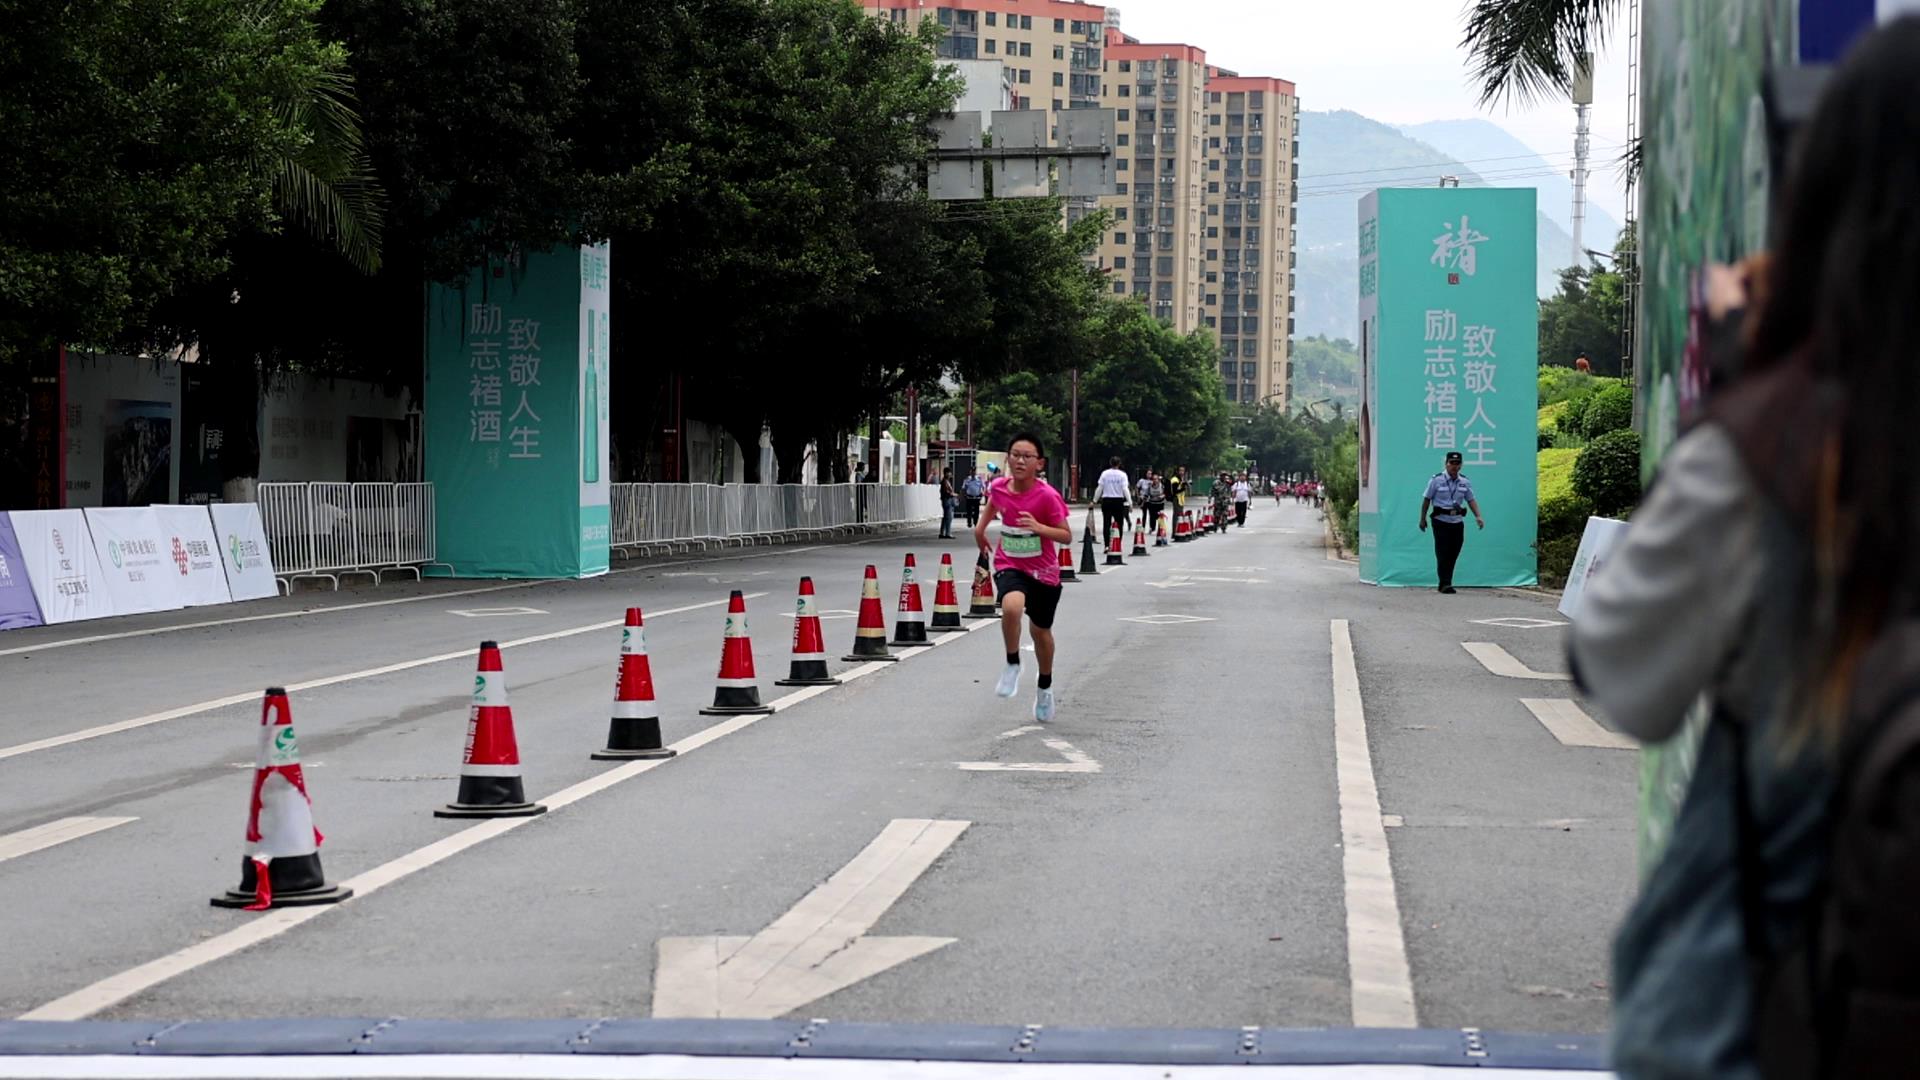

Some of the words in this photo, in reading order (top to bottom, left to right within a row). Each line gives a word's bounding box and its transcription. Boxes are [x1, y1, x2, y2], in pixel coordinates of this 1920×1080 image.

[469, 303, 503, 443] 励志褚酒
[508, 318, 541, 459] 致敬人生
[1424, 310, 1457, 449] 励志褚酒
[1463, 325, 1496, 466] 致敬人生
